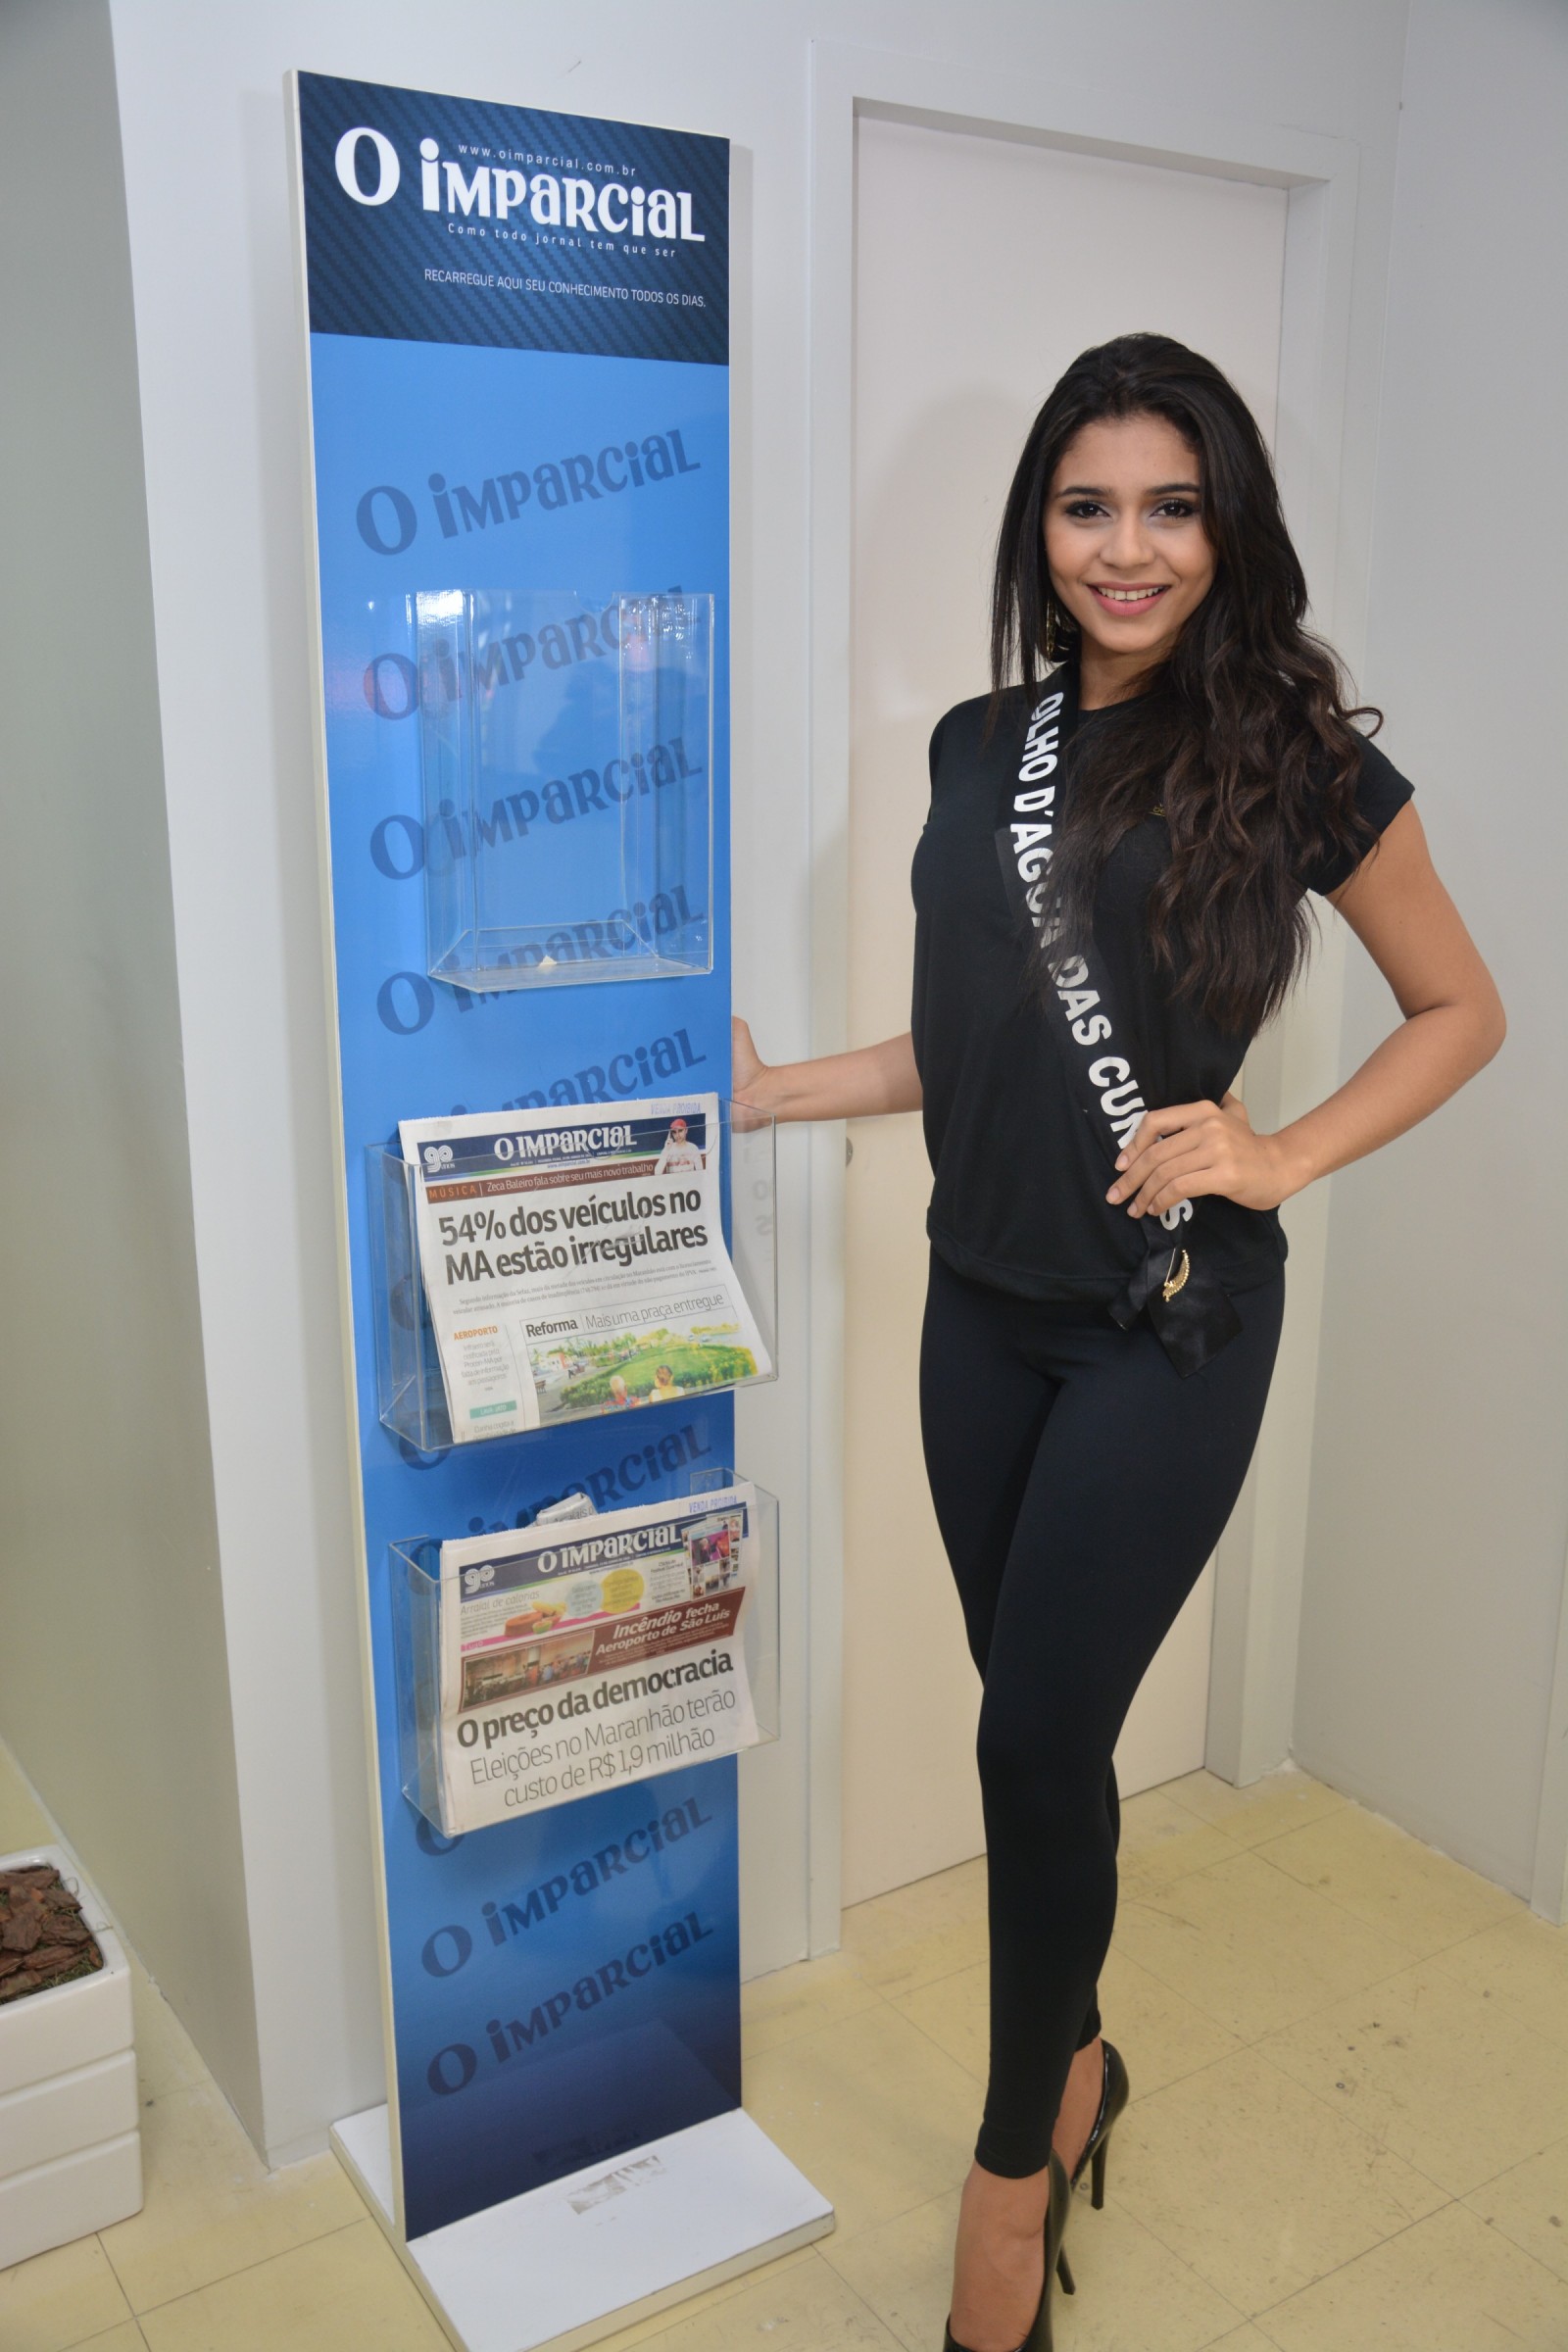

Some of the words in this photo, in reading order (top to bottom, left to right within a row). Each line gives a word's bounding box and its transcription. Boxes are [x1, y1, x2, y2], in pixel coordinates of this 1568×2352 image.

[334, 126, 401, 207] O
[459, 143, 636, 176] www.oimparcial.com.br
[448, 222, 486, 237] Como
[495, 229, 527, 242] todo
[536, 233, 582, 248] jornal
[590, 240, 614, 252] tem
[623, 244, 647, 256] que
[655, 248, 676, 258] ser
[424, 269, 495, 287] RECARREGUE
[497, 275, 522, 290] AQUI
[525, 278, 546, 292] SEU
[548, 280, 629, 301] CONHECIMENTO
[631, 289, 663, 304] TODOS
[666, 293, 679, 305] OS
[682, 294, 706, 308] DIAS.
[356, 485, 417, 556] O
[369, 814, 425, 880] O
[1018, 691, 1064, 782] OLHO
[1048, 955, 1112, 1046] DAS
[376, 971, 434, 1035] O
[494, 1137, 514, 1161] O
[428, 1185, 477, 1199] MÚSICA
[487, 1182, 505, 1193] Zeca
[507, 1179, 533, 1190] Baleiro
[534, 1175, 549, 1187] fala
[550, 1174, 569, 1185] sobre
[570, 1172, 585, 1182] seu
[585, 1168, 603, 1179] mais
[621, 1163, 654, 1175] trabalho
[438, 1209, 507, 1247] 54%
[510, 1205, 558, 1237] dos
[560, 1191, 666, 1230] veículos
[669, 1189, 702, 1214] no
[445, 1250, 496, 1286] MA
[496, 1241, 568, 1277] estão
[569, 1224, 709, 1267] irregulares
[454, 1325, 499, 1341] AEROPORTO
[525, 1319, 579, 1338] Reforma
[585, 1315, 610, 1330] Mais
[612, 1311, 638, 1324] uma
[641, 1304, 673, 1323] praça
[674, 1294, 724, 1311] entregue
[537, 1550, 558, 1573] O
[596, 1631, 660, 1655] Aeroporto
[662, 1625, 676, 1637] de
[680, 1618, 704, 1631] São
[706, 1609, 730, 1624] Luís
[612, 1610, 682, 1640] Incêndio
[686, 1602, 719, 1619] fecha
[457, 1719, 479, 1748] O
[483, 1704, 554, 1749] preço
[557, 1691, 591, 1720] da
[592, 1648, 734, 1710] democracia
[470, 1744, 553, 1786] Eleições
[556, 1736, 582, 1760] no
[584, 1704, 686, 1751] Maranhão
[688, 1689, 736, 1719] terão
[505, 1776, 558, 1807] custo
[561, 1765, 586, 1789] de
[588, 1751, 616, 1782] R$
[618, 1744, 644, 1776] 1,9
[647, 1728, 715, 1764] milhão
[421, 1925, 473, 1978] O
[427, 2043, 478, 2096] O
